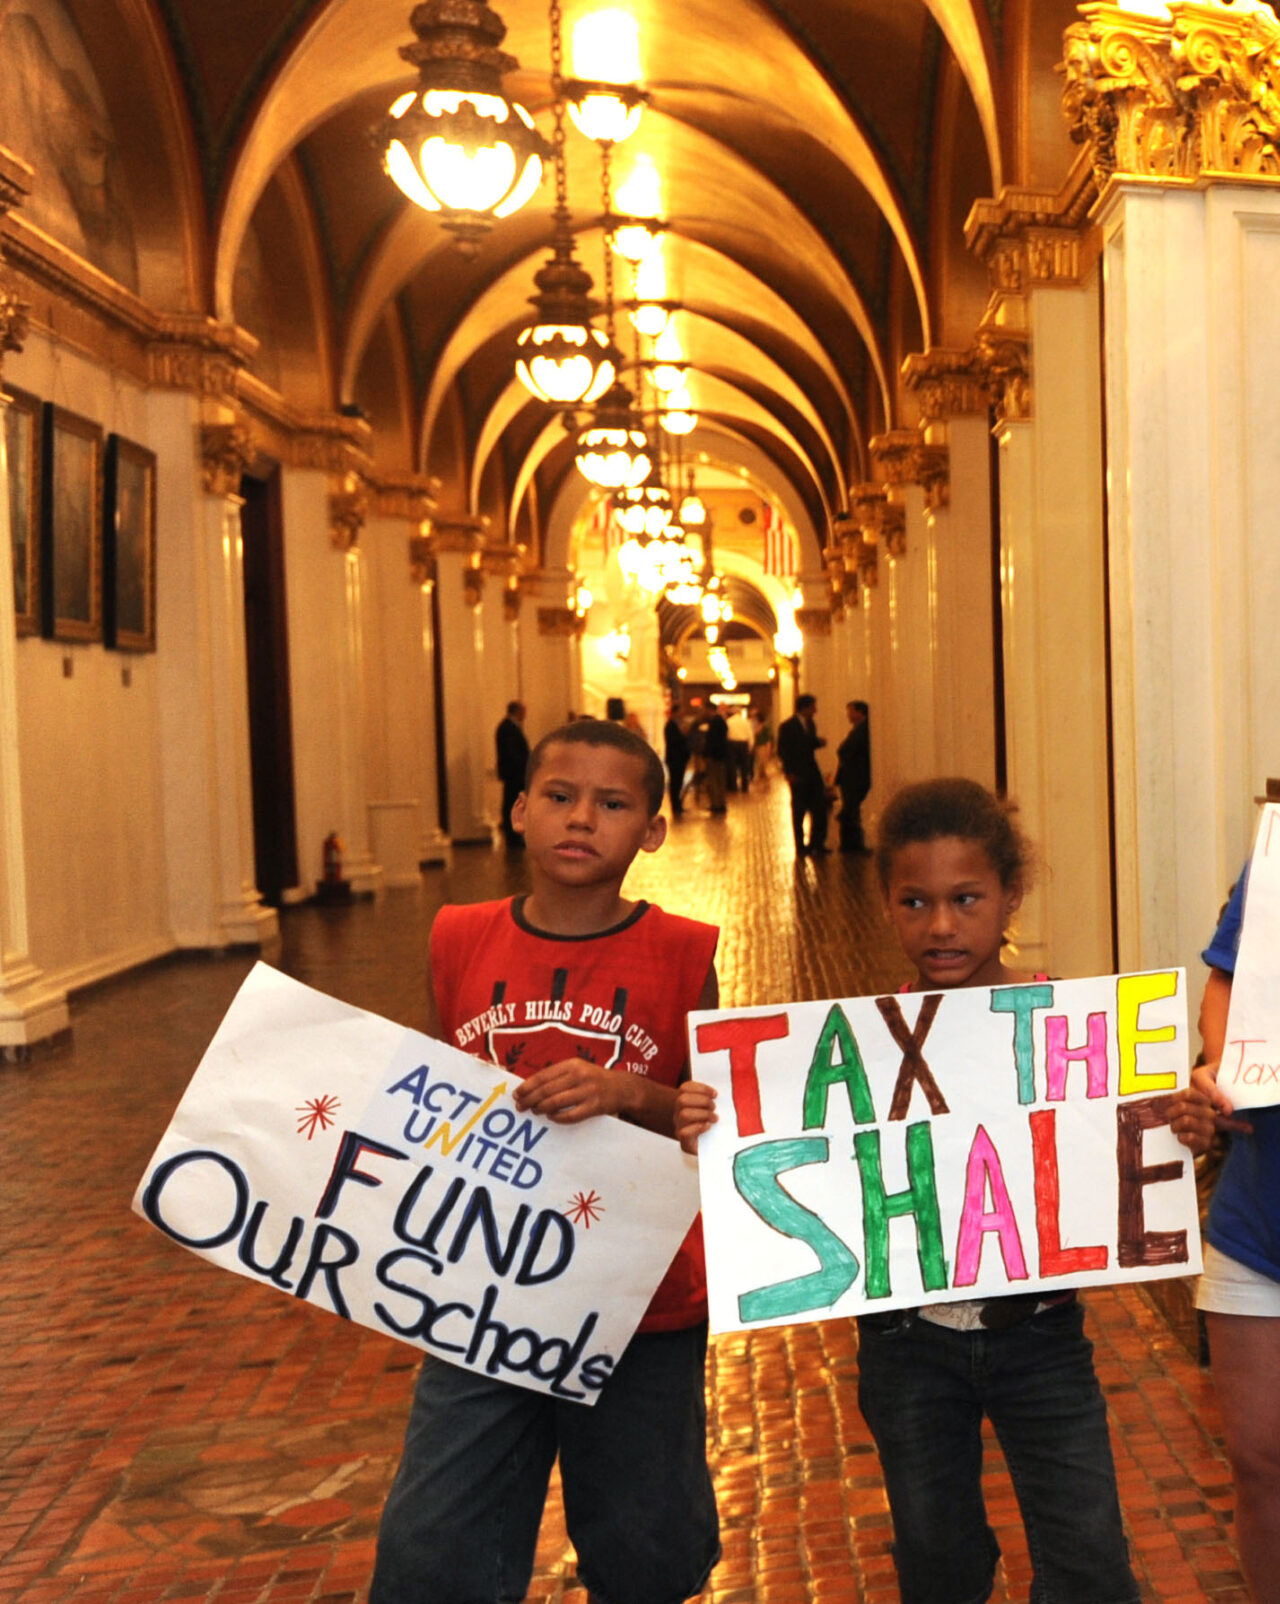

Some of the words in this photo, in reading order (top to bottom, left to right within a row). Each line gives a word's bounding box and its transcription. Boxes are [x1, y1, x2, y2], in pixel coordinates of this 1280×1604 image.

[455, 1003, 516, 1047] BEVERLY
[525, 1000, 573, 1021] HILLS
[579, 1004, 622, 1033] POLO
[625, 1023, 658, 1061] CLUB
[696, 993, 950, 1137] TAX
[990, 971, 1178, 1105] THE
[1229, 1039, 1280, 1085] Tax
[314, 1130, 576, 1286] FUND
[403, 1109, 543, 1190] UNITED
[733, 1092, 1189, 1323] SHALE
[374, 1248, 614, 1399] Schools
